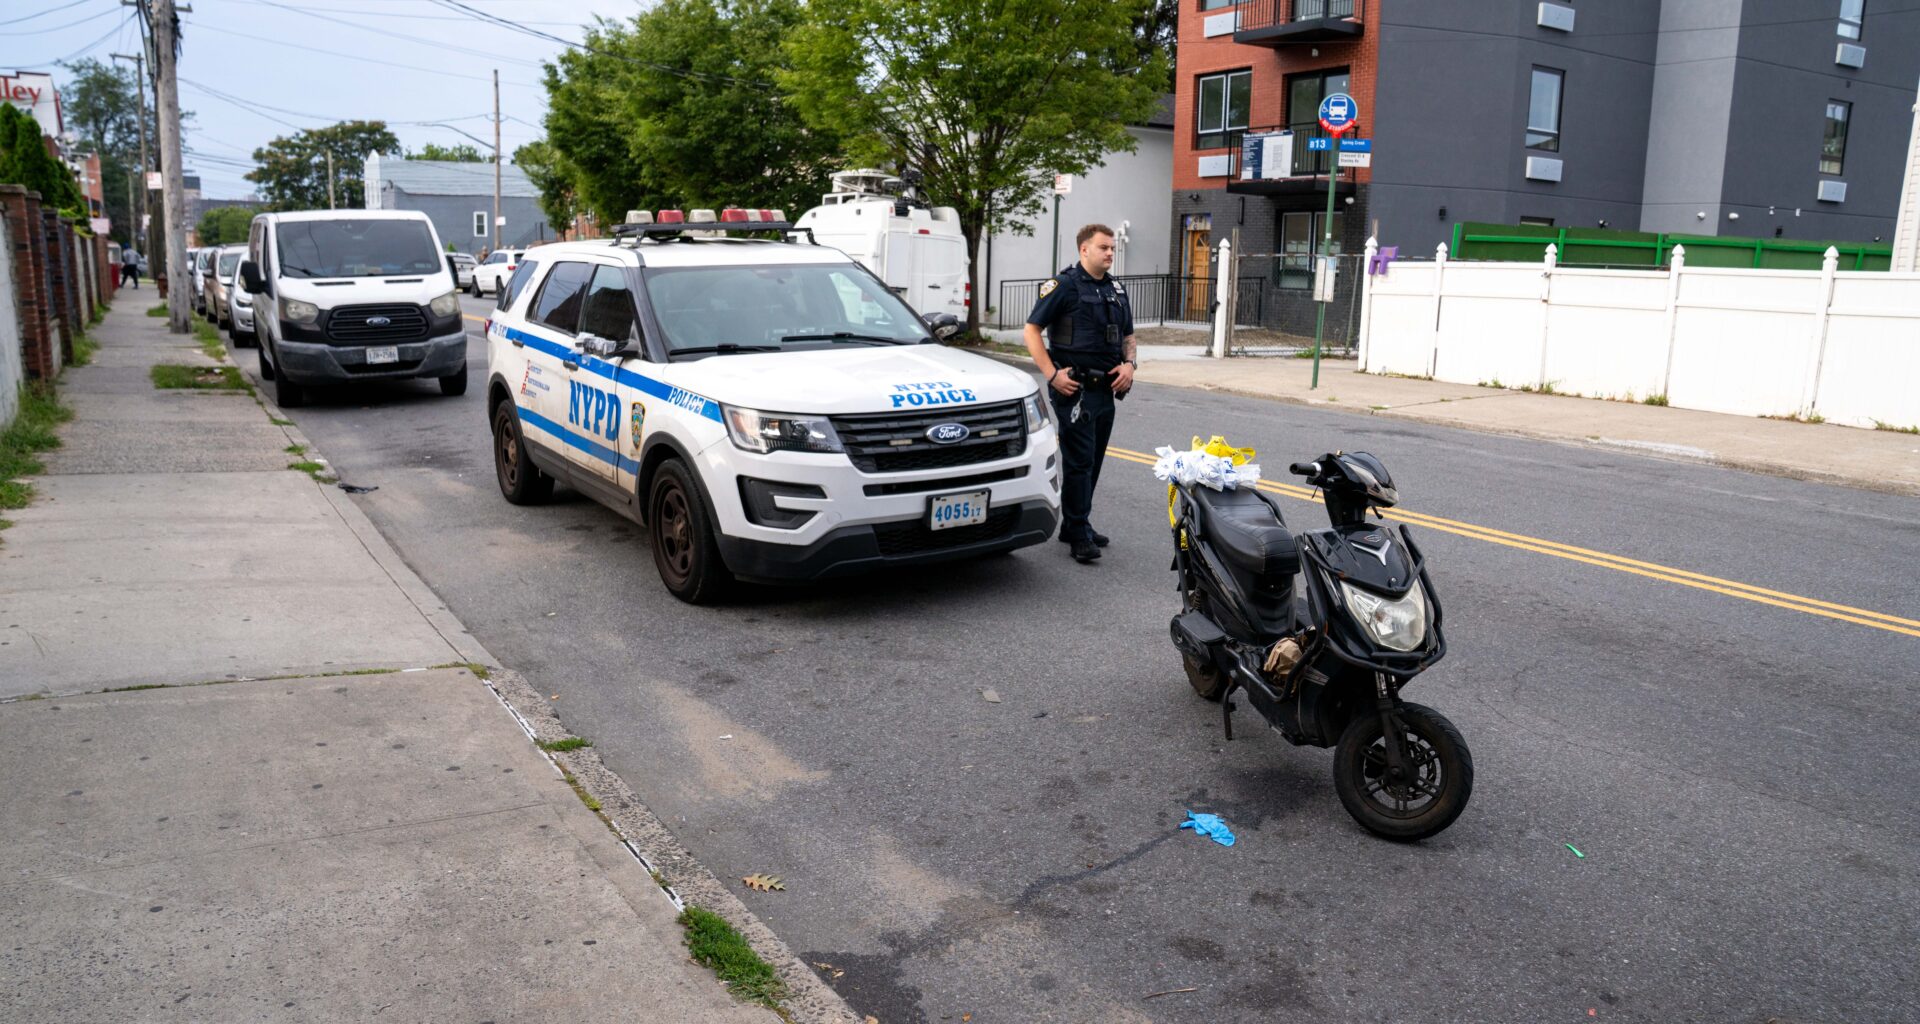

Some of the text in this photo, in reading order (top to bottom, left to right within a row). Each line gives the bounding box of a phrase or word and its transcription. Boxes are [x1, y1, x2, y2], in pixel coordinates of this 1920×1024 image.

[892, 382, 953, 392] NYPD
[669, 387, 705, 414] POLICE
[889, 389, 977, 408] POLICE
[569, 379, 622, 442] NYPD
[939, 426, 961, 439] Ford
[935, 502, 981, 522] 4055 17
